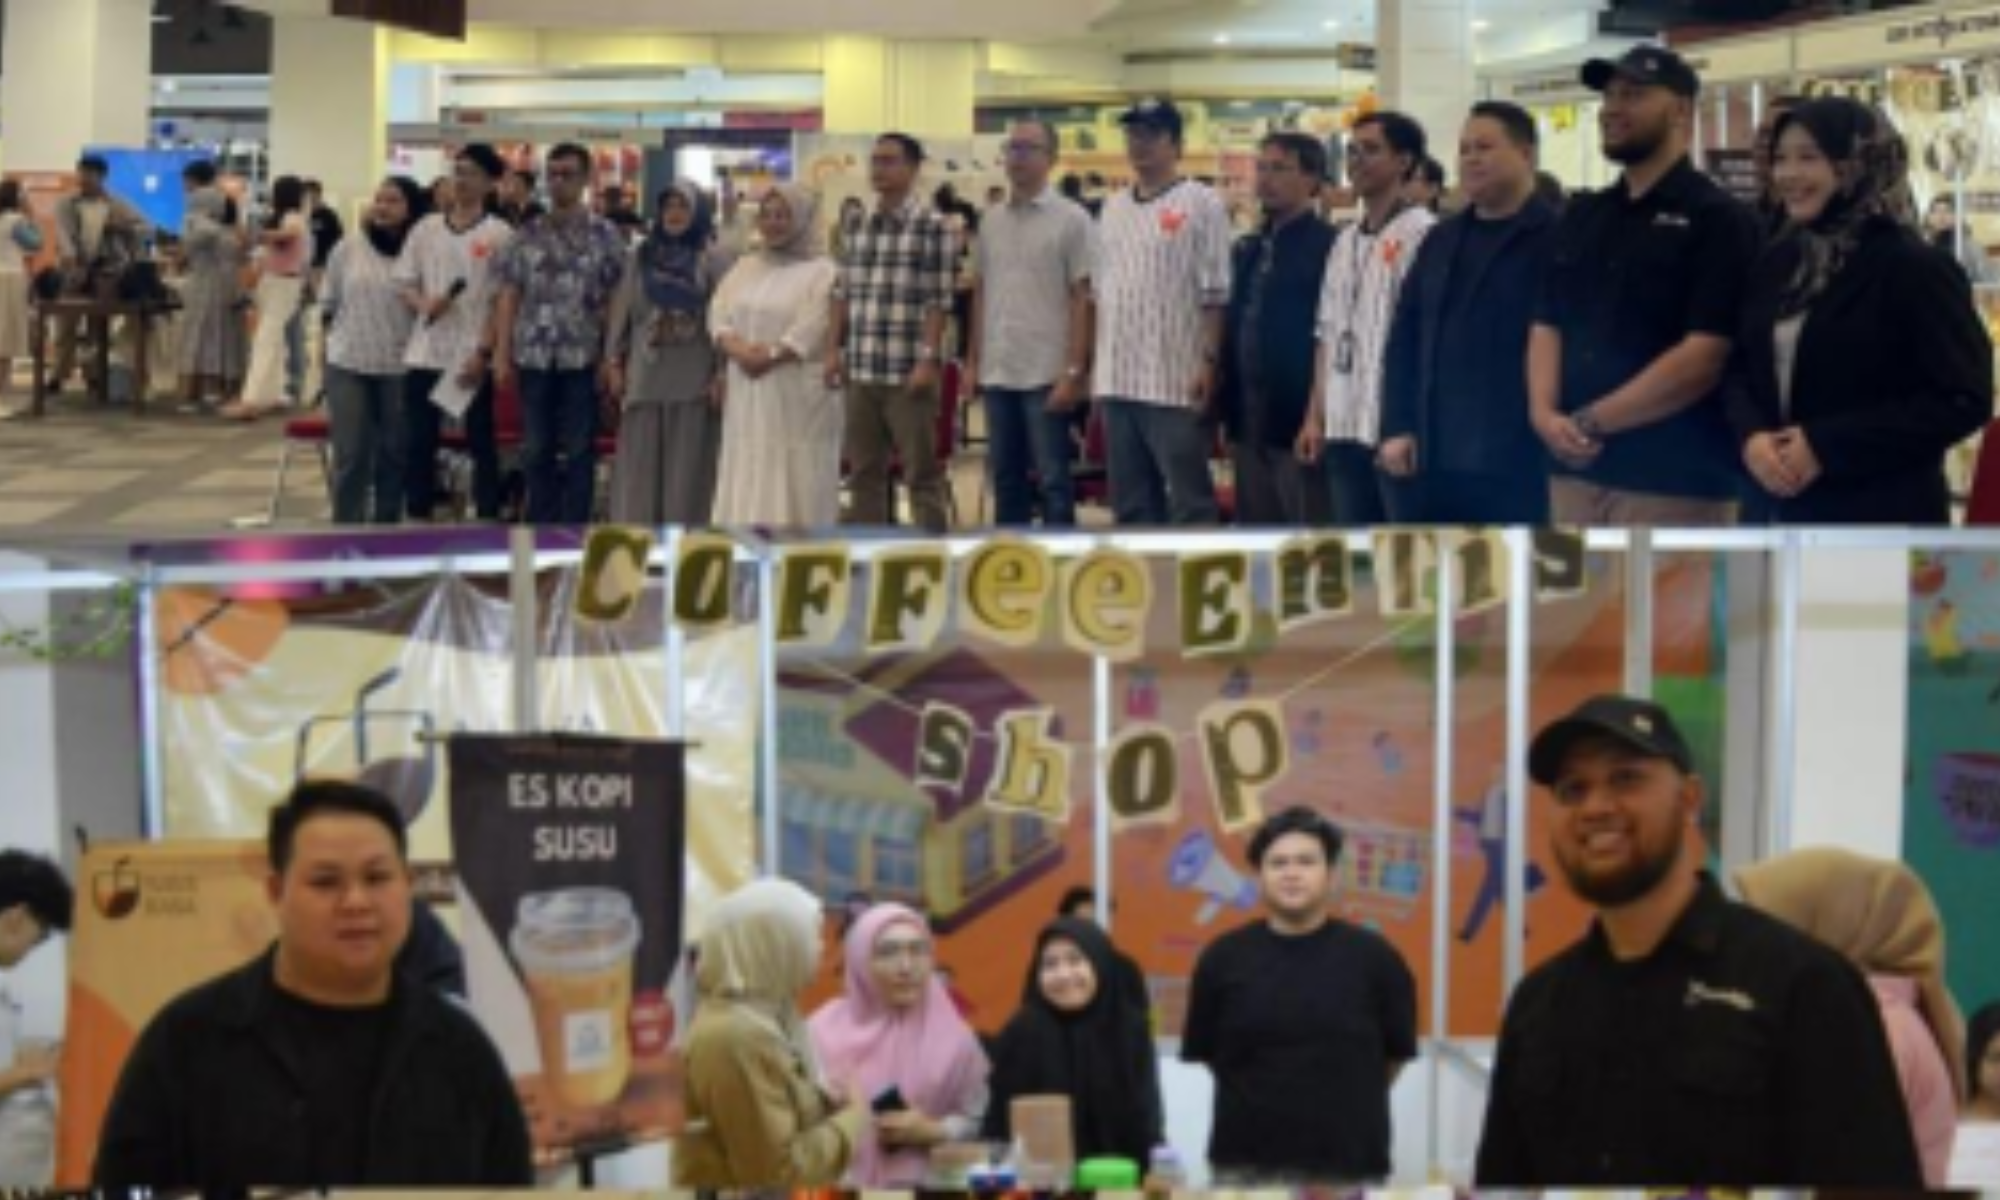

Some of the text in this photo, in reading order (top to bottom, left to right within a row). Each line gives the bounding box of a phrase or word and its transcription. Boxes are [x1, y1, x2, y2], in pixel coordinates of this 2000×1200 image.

[507, 772, 633, 808] ES KOPI
[533, 825, 617, 861] SUSU
